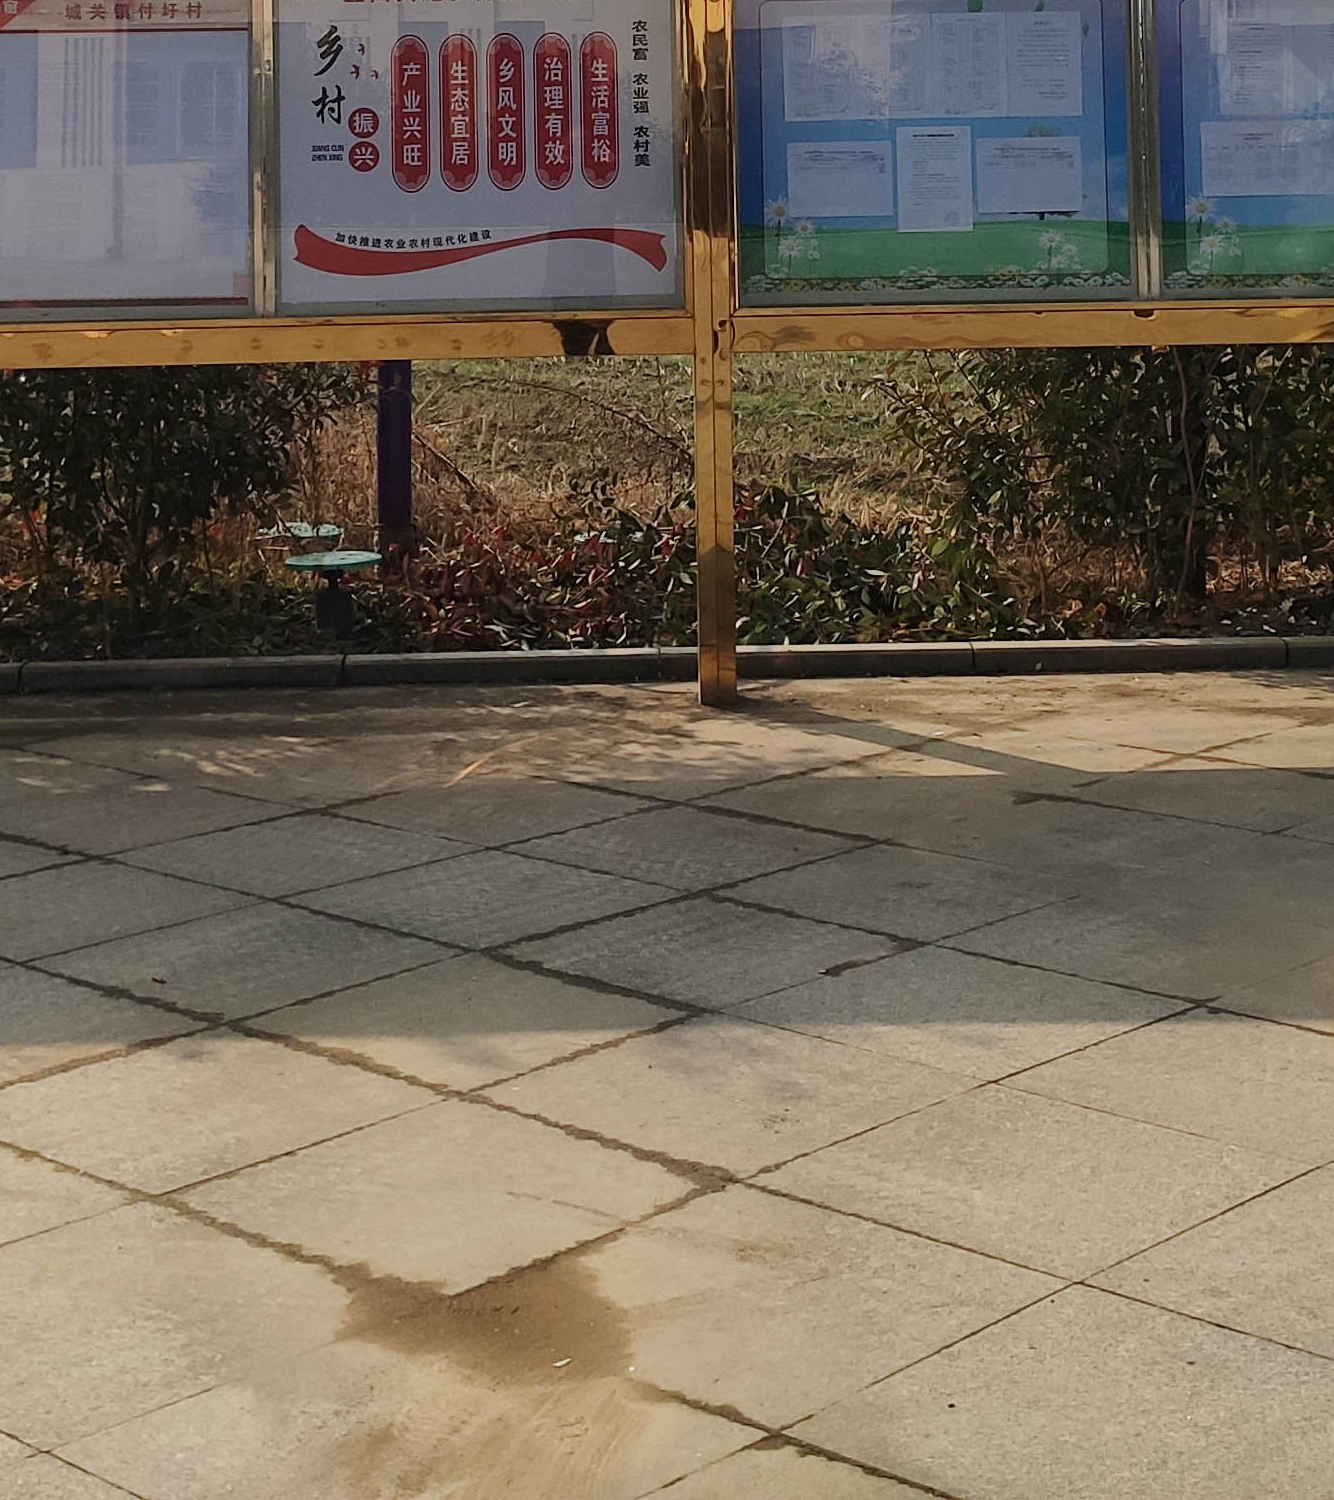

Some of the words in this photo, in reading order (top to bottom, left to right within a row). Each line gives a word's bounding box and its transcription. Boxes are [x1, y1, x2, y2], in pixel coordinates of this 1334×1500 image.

[311, 24, 346, 125] 乡村
[401, 61, 423, 168] 产业兴旺
[449, 60, 470, 167] 生态宜居
[497, 57, 519, 167] 乡风文明
[543, 56, 565, 167] 治理有效
[589, 57, 611, 164] 生活富裕
[352, 112, 376, 168] 振兴
[335, 229, 492, 250] 加快推进农业农村现代化建设
